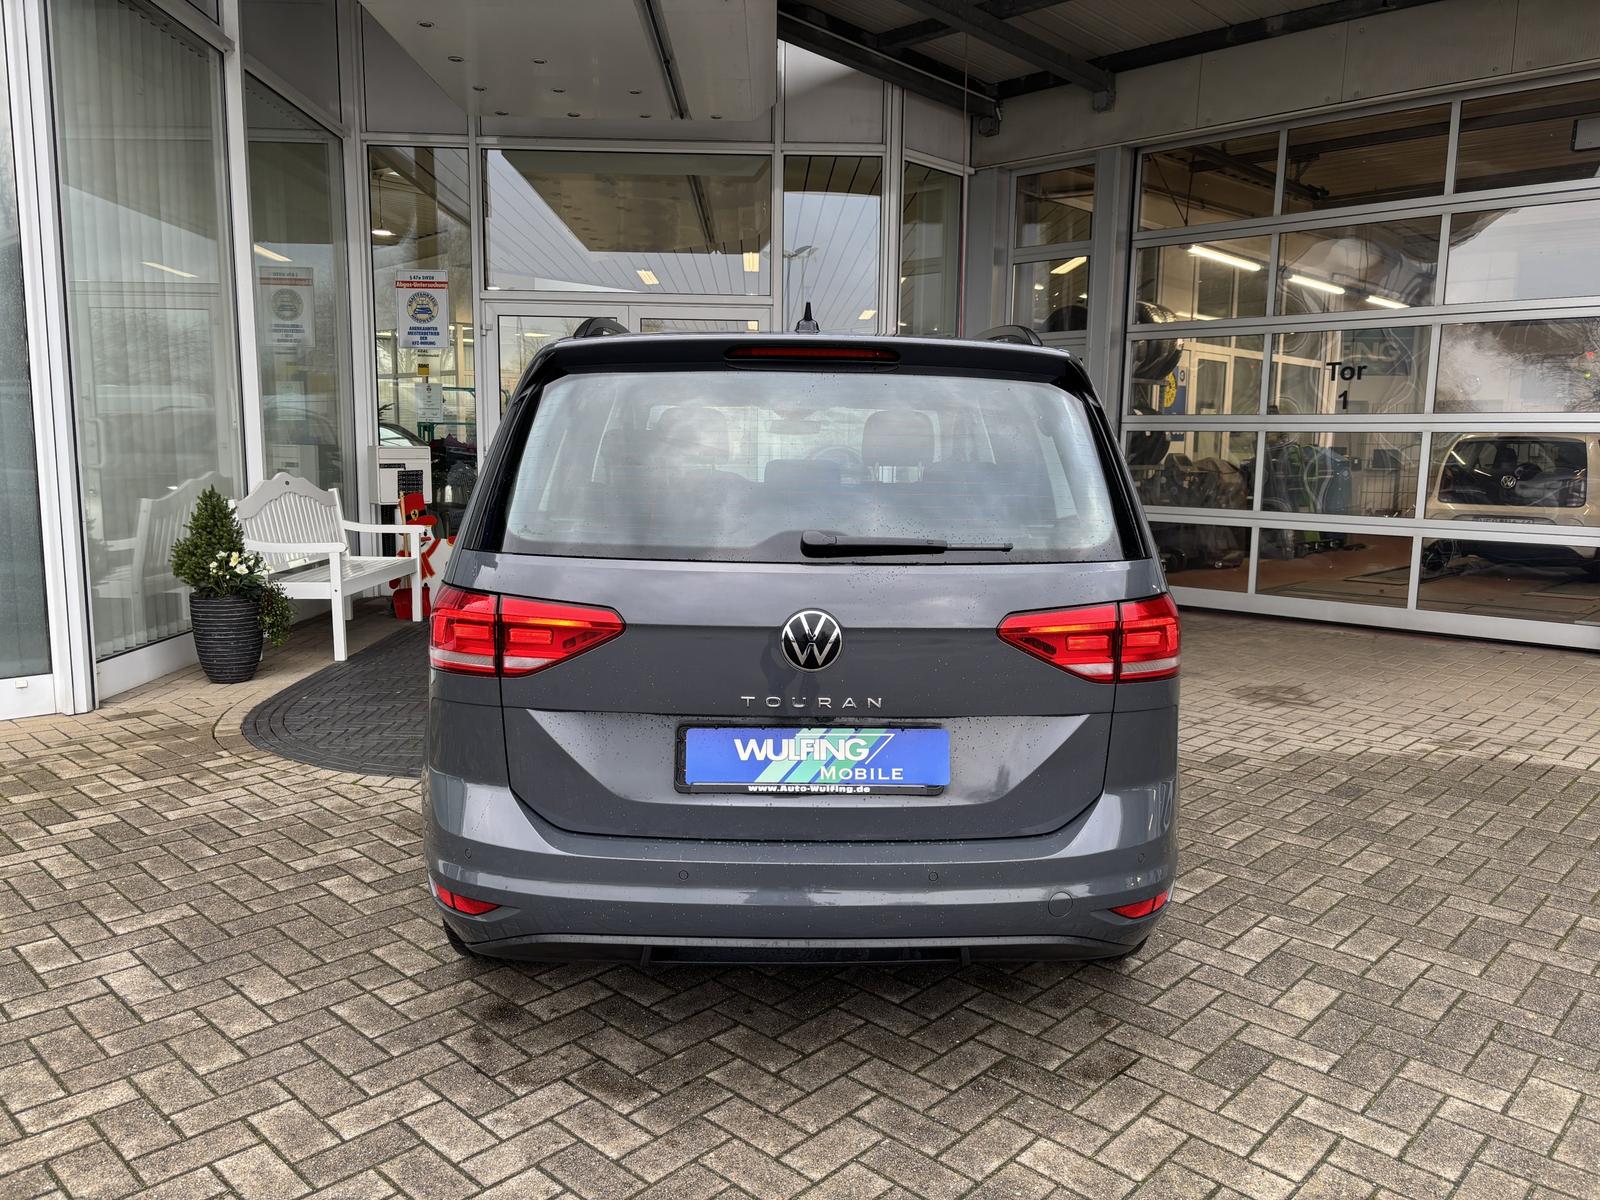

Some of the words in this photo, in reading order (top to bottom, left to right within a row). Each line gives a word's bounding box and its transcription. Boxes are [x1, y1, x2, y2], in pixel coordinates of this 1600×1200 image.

[1326, 362, 1368, 381] Tor
[1338, 390, 1348, 410] 1
[740, 696, 883, 708] TOURAN
[733, 738, 869, 761] WULFING
[820, 766, 904, 780] MOBILE
[748, 785, 870, 794] www.Auto-Wulfing.de
